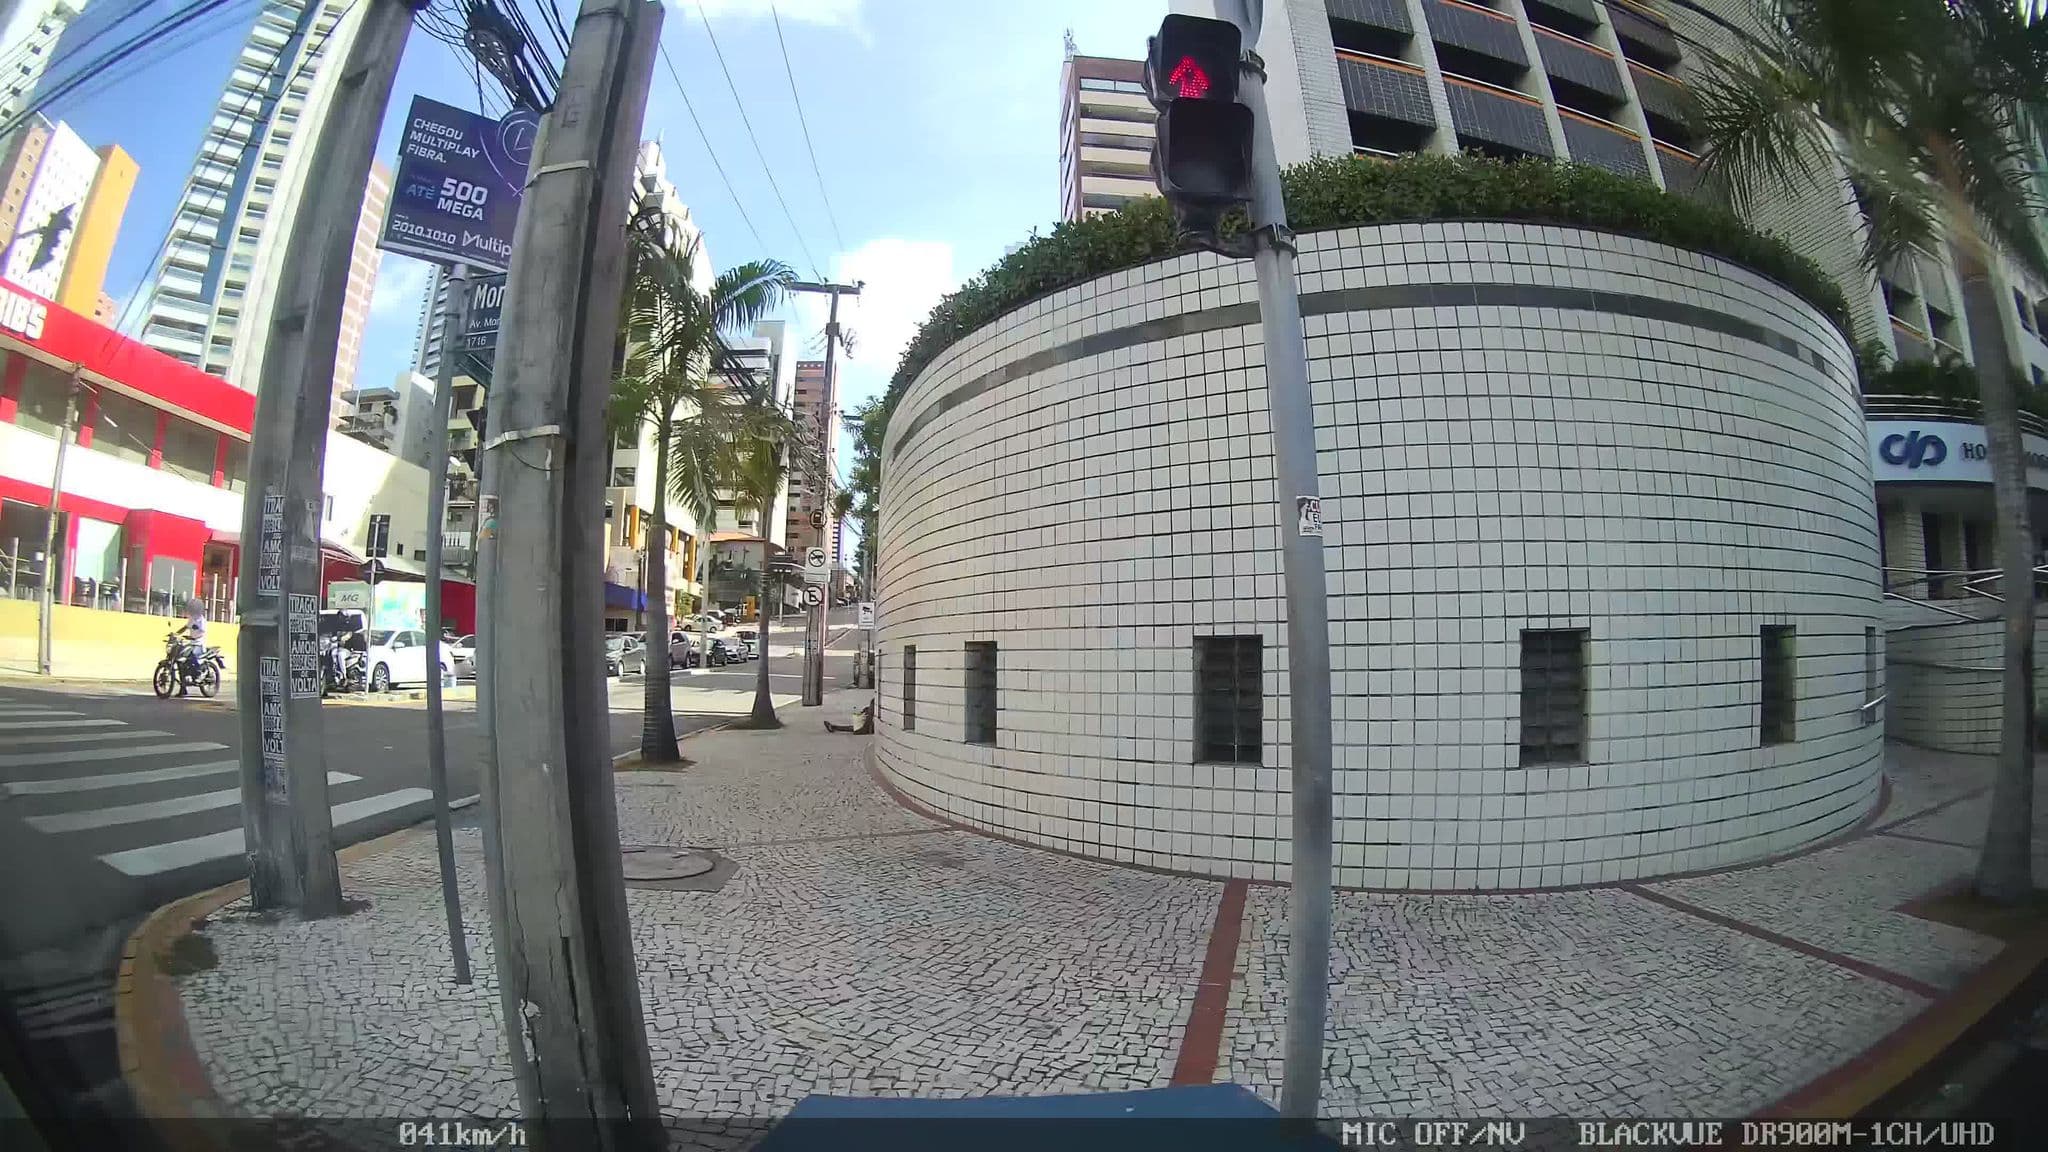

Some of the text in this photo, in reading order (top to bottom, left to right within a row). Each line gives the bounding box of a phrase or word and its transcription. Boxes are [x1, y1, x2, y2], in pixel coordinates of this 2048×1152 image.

[413, 118, 464, 141] CHEGOU
[406, 143, 447, 164] FIBRA.
[409, 130, 480, 159] MULTIPLAY
[405, 183, 436, 201] ATÉ
[439, 177, 488, 206] 500
[436, 197, 484, 221] MEGA
[391, 219, 457, 245] 2010.1010
[484, 318, 501, 327] Mo
[467, 336, 487, 347] 1716
[290, 597, 316, 614] TRAGO
[291, 640, 316, 654] AMOR
[291, 677, 317, 693] VOLTA
